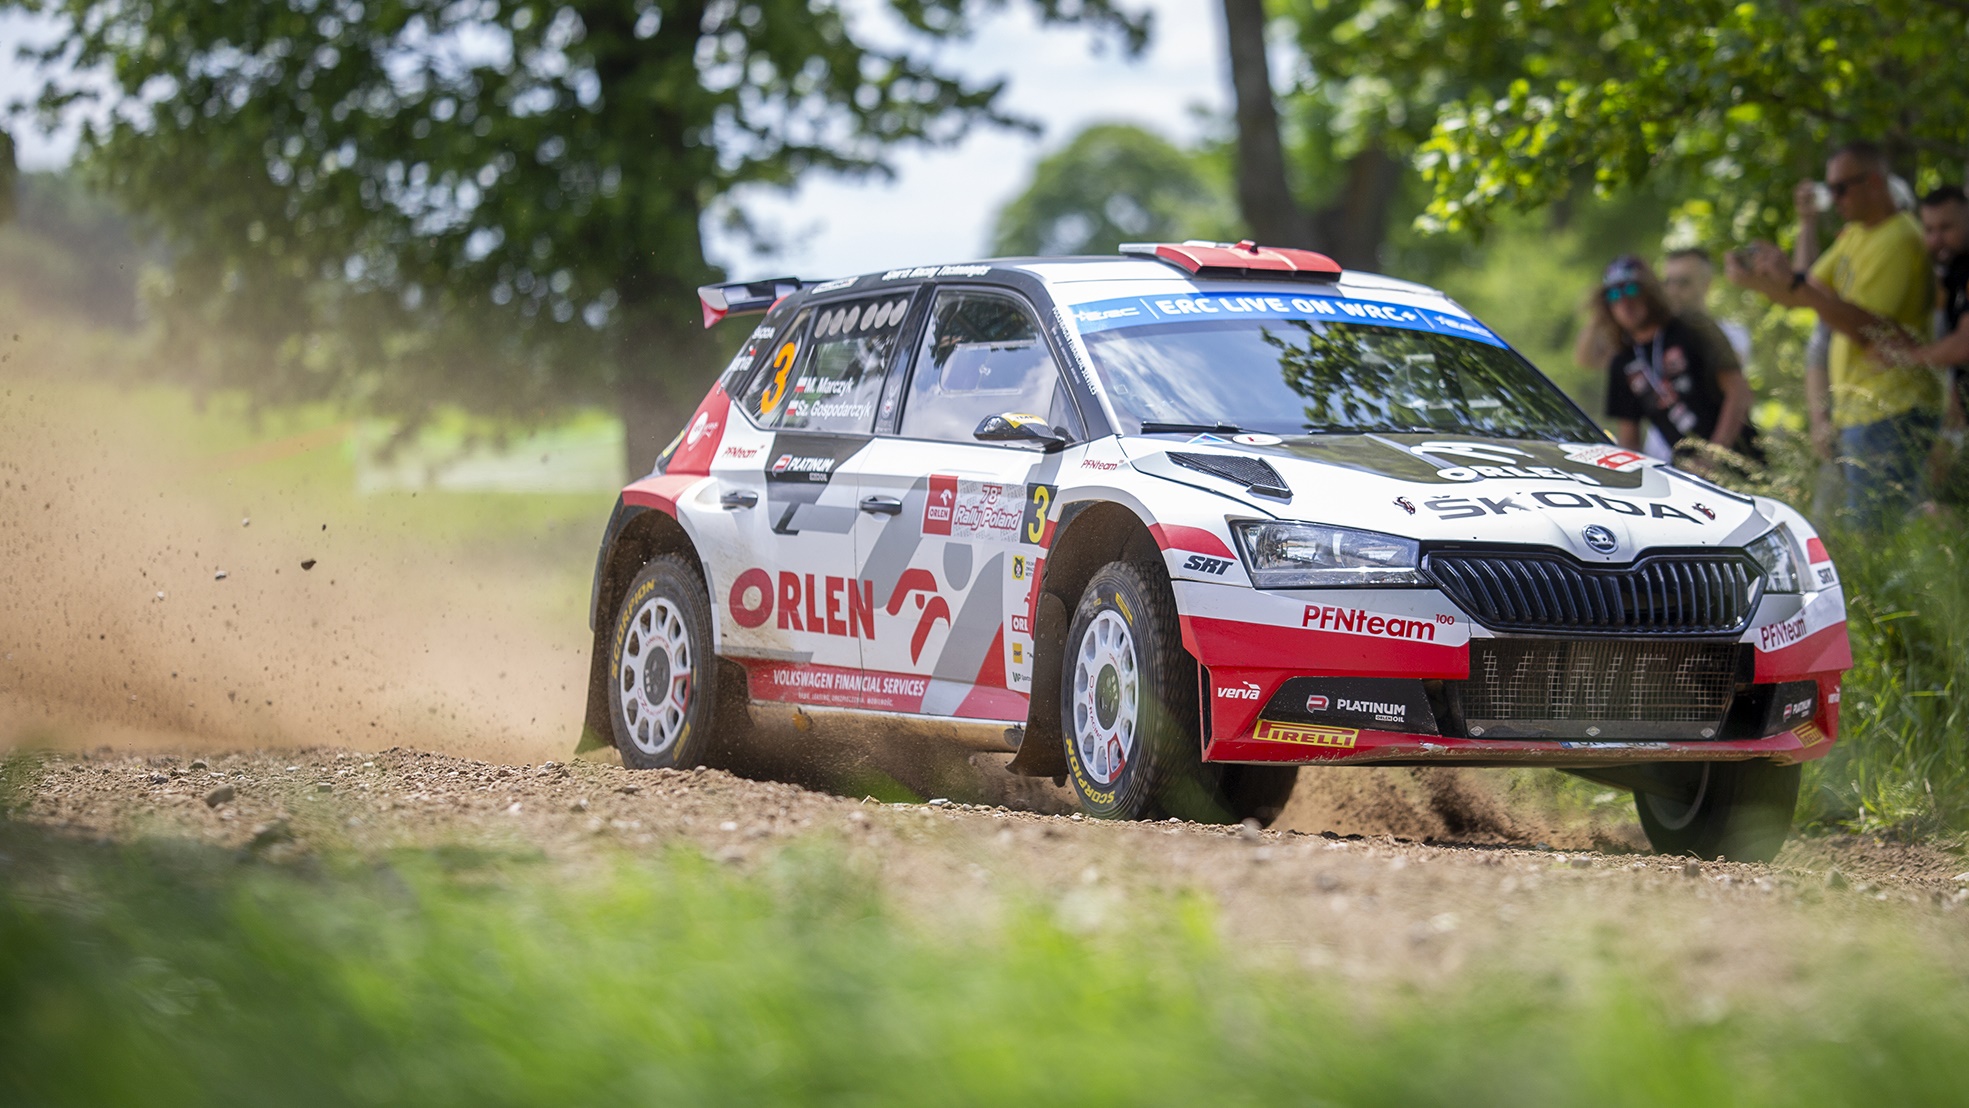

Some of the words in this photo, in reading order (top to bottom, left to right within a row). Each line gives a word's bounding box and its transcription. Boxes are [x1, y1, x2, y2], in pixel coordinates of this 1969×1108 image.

[1154, 297, 1220, 315] ERC
[1218, 297, 1290, 314] LIVE
[1290, 298, 1336, 315] ON
[1335, 301, 1417, 322] WRC+
[761, 342, 796, 415] 3
[803, 378, 815, 394] M.
[816, 377, 854, 400] Marczyk
[810, 400, 872, 421] Gospodarczyk
[787, 457, 836, 472] PLATINUM
[1081, 459, 1118, 471] PFNteam
[1436, 465, 1602, 486] ORLEN
[929, 508, 948, 519] ORLEN
[955, 505, 983, 530] Rally
[981, 508, 1022, 530] Poland
[1028, 485, 1049, 543] 3
[1424, 491, 1704, 525] ŠKODA
[1183, 555, 1234, 576] SRT
[1817, 567, 1835, 585] SRT
[729, 567, 875, 640] ORLEN
[612, 578, 657, 680] SCORPION
[1302, 604, 1435, 641] PFNteam
[1435, 613, 1456, 626] 100
[1761, 618, 1807, 650] PFNteam
[773, 669, 833, 690] VOLKSWAGEN
[834, 674, 881, 693] FINANCIAL
[882, 678, 926, 698] SERVICES
[1217, 684, 1261, 701] verva
[1337, 698, 1406, 716] PLATINUM
[1254, 720, 1358, 748] PIRELLI
[1065, 738, 1116, 804] SCORPION
